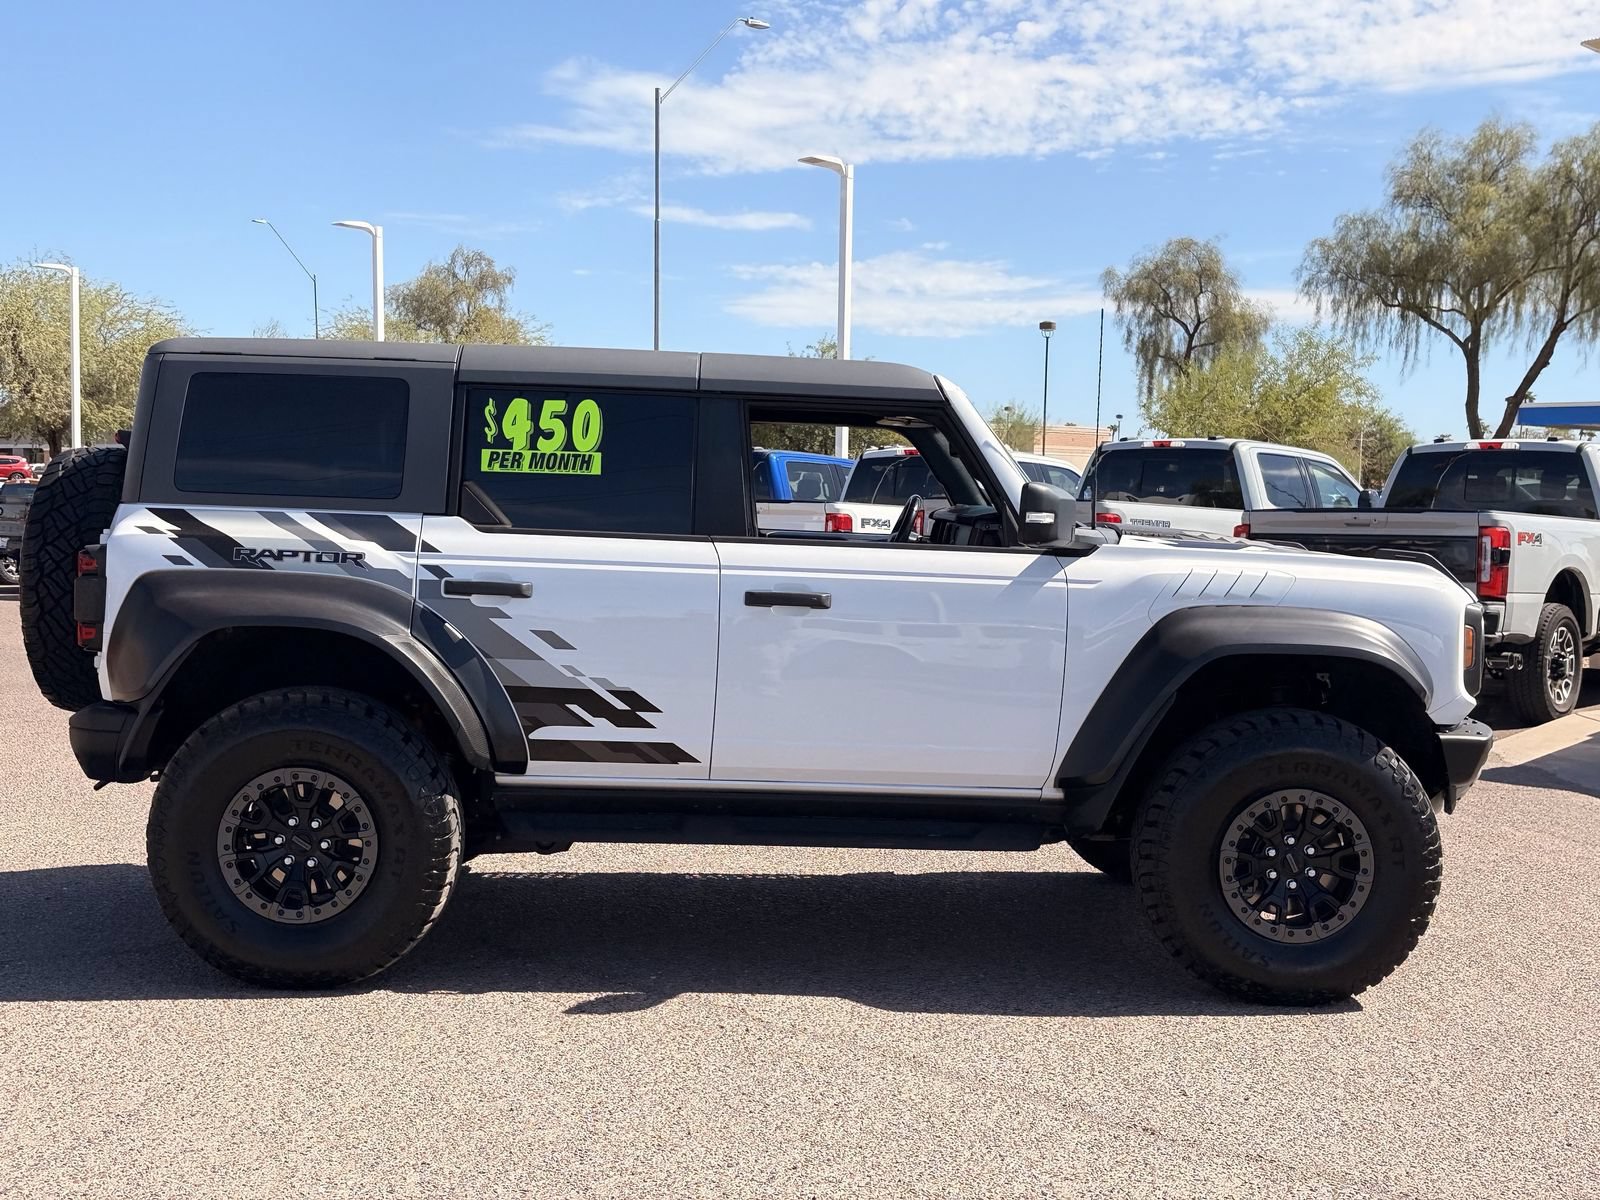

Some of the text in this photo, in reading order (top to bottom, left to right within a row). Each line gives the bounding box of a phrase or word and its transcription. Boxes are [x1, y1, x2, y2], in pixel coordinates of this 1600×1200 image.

[484, 398, 603, 452] $450
[487, 451, 594, 473] PER MONTH
[860, 517, 891, 529] FX4
[1517, 531, 1542, 546] FX4
[233, 547, 368, 571] RAPTOR
[288, 737, 406, 833] TERRAMAX
[1258, 760, 1394, 827] TERRAMAX
[186, 850, 241, 934] SAILUN
[1198, 903, 1273, 968] SAILUN
